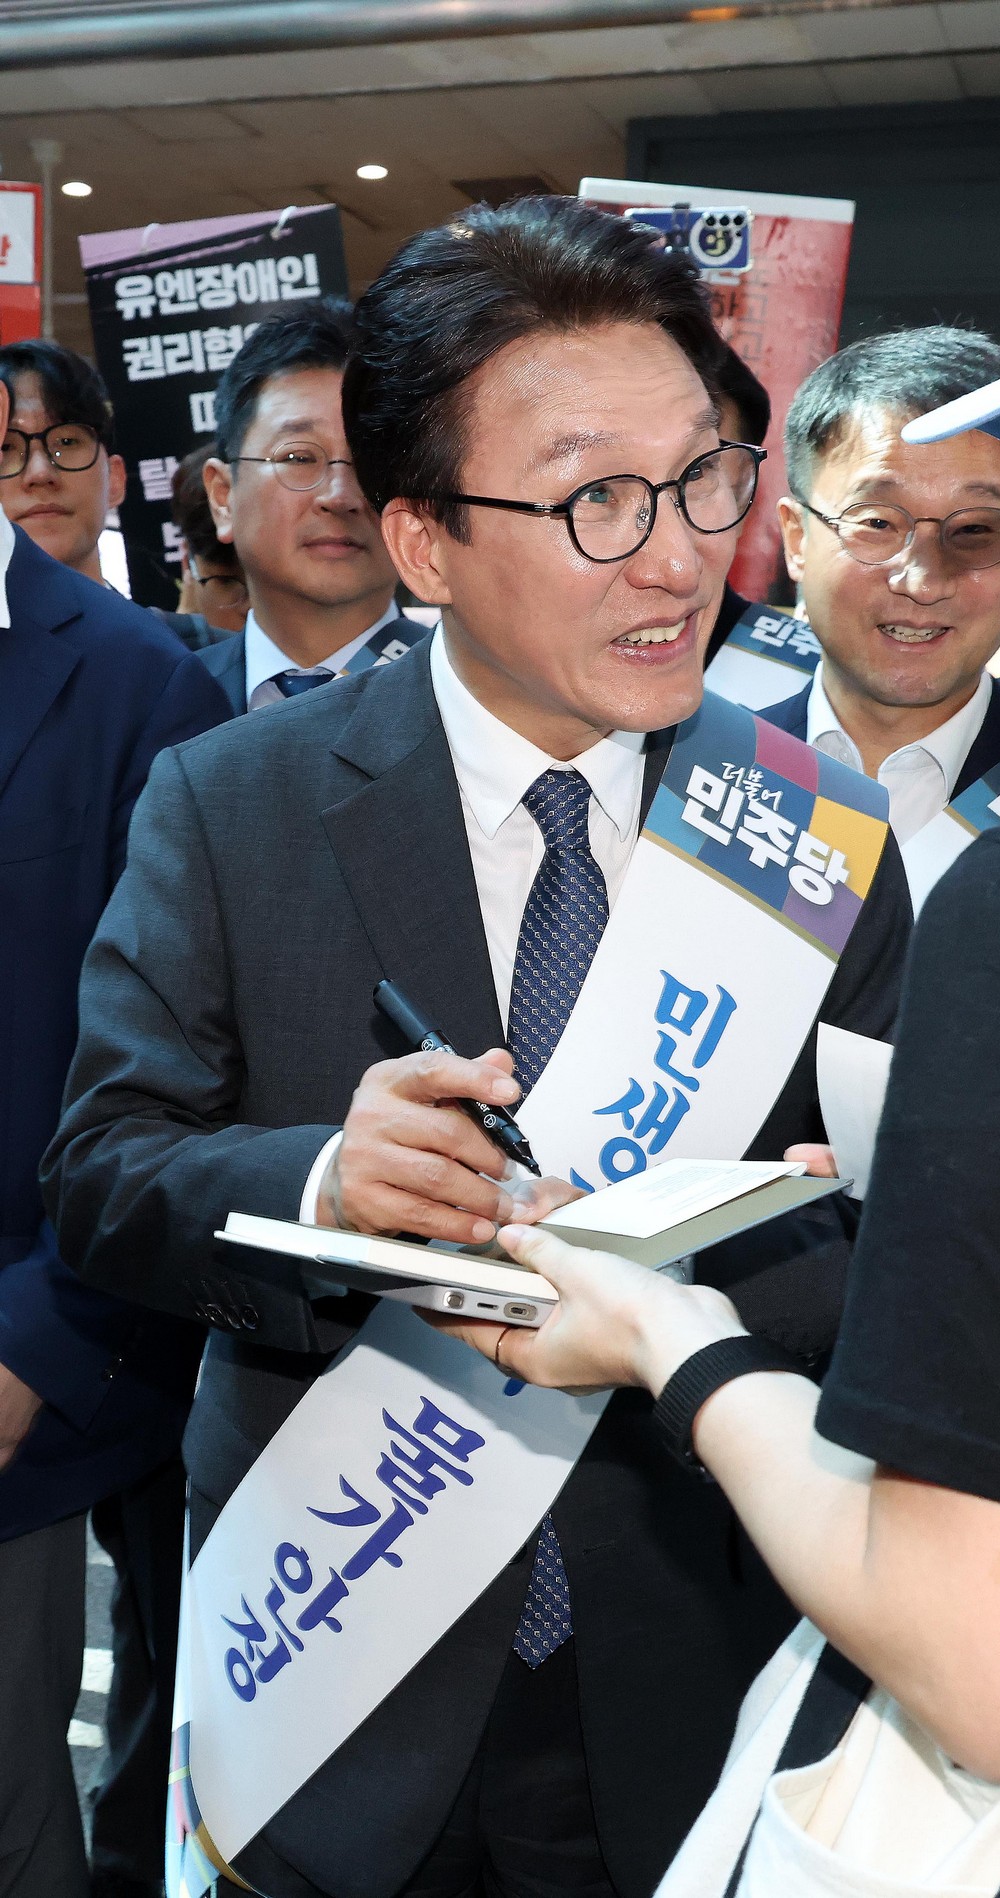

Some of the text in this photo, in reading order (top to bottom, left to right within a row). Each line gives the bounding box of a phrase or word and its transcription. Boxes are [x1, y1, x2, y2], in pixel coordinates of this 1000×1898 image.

[115, 253, 321, 321] 유엔장애인
[122, 322, 261, 381] 권리협
[750, 615, 822, 656] 민주
[721, 762, 784, 812] 더불어
[681, 764, 850, 906] 민주당
[592, 969, 738, 1184] 민생
